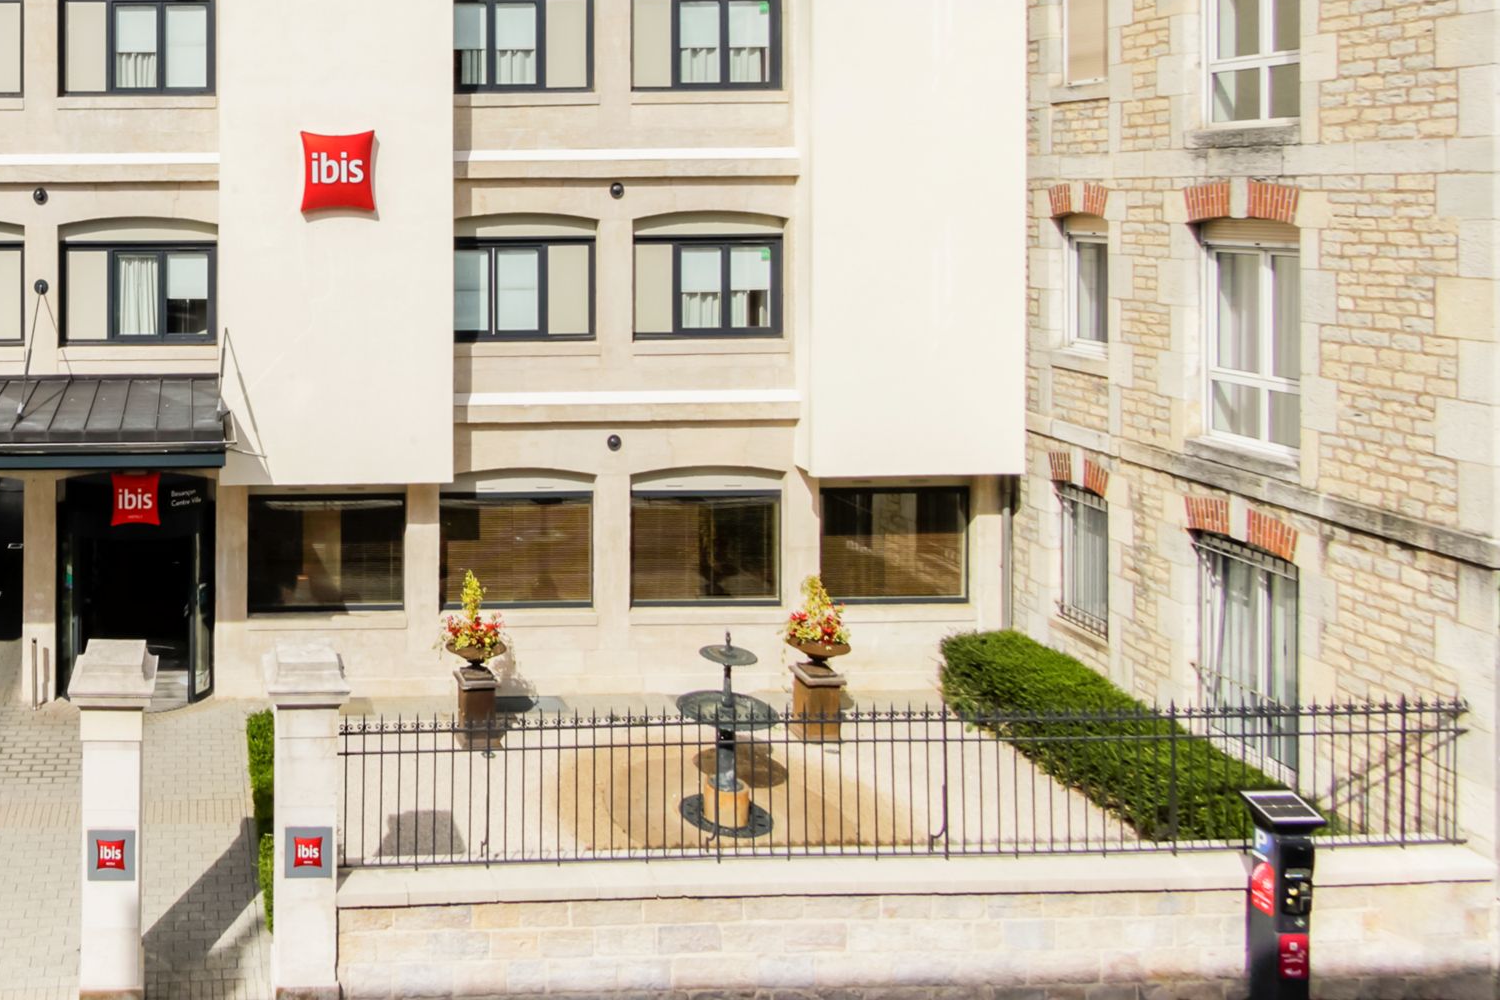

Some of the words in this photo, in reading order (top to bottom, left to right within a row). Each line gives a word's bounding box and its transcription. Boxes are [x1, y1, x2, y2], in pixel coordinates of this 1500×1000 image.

[311, 151, 364, 184] ibis
[118, 488, 153, 510] ibis
[100, 845, 122, 860] ibis
[297, 844, 320, 859] ibis
